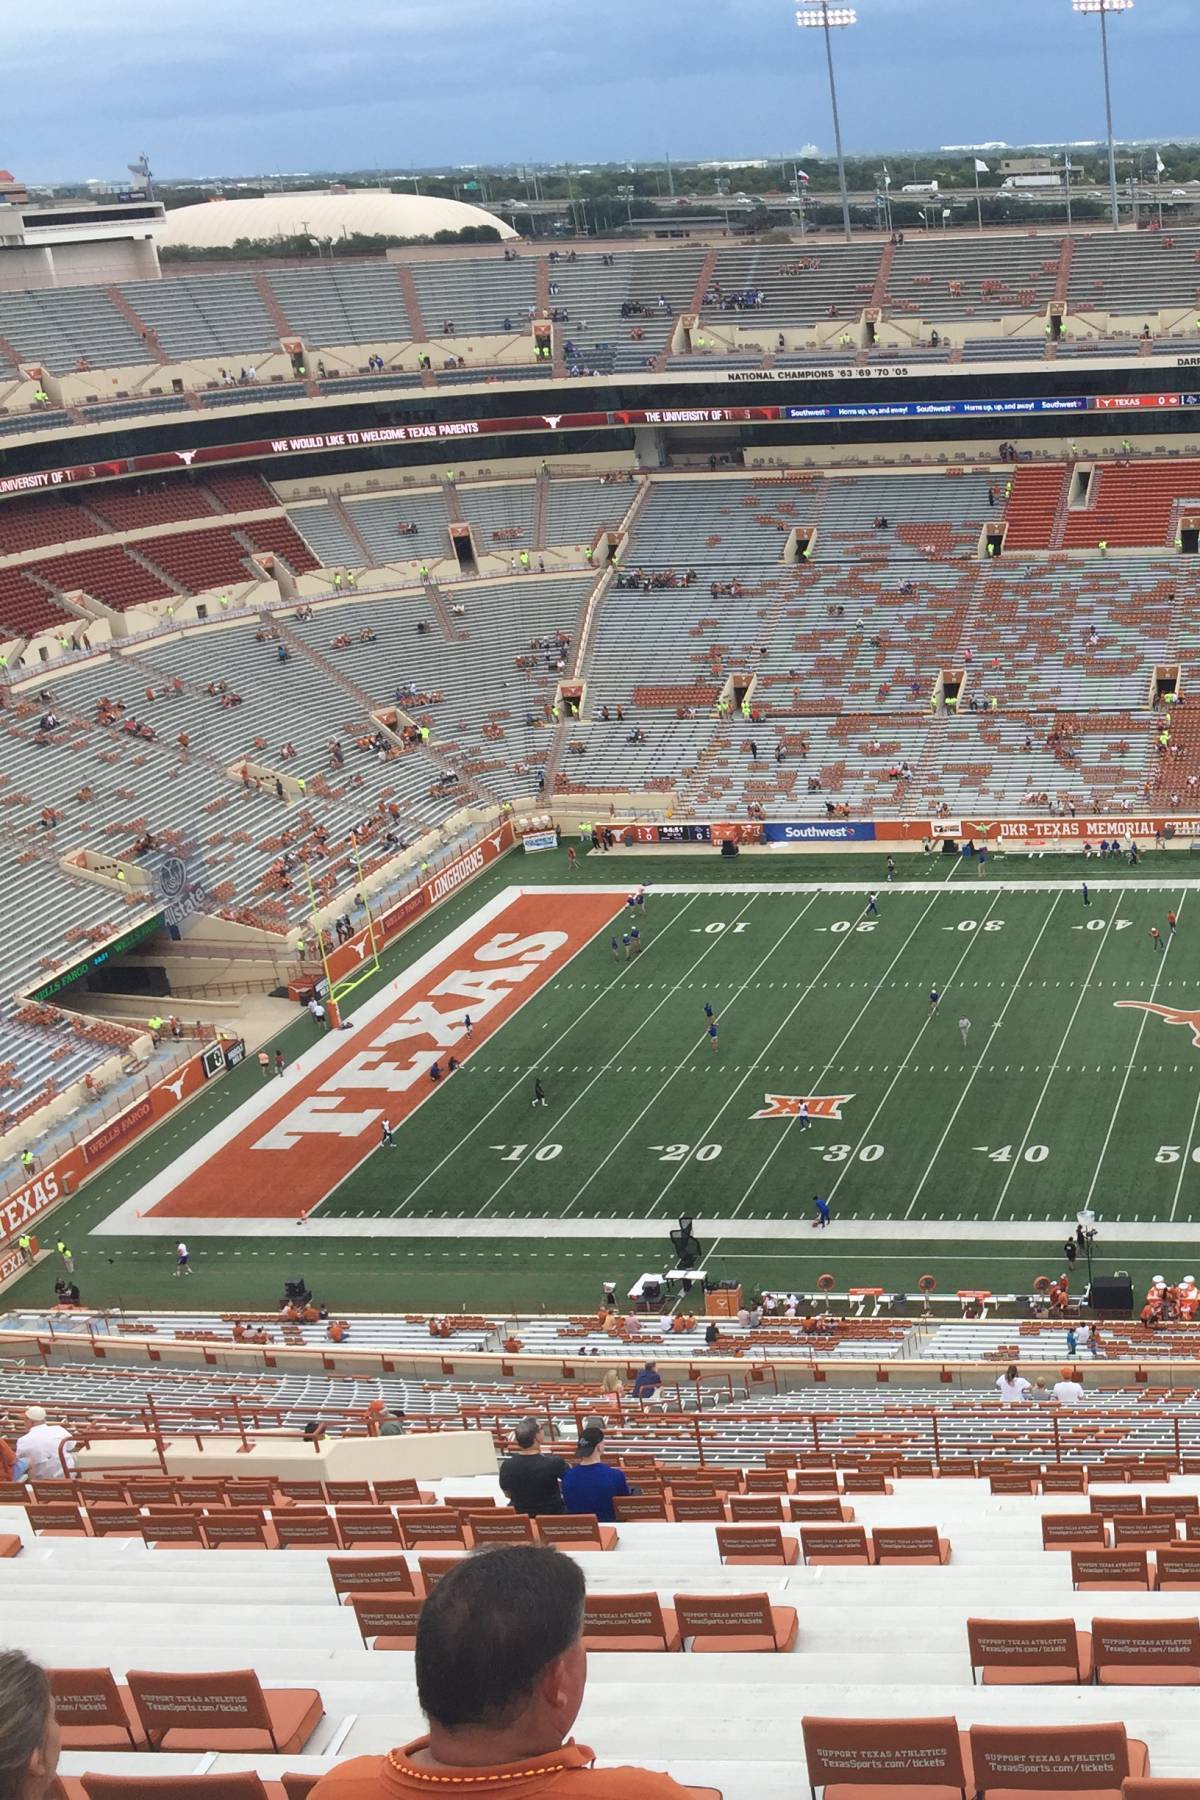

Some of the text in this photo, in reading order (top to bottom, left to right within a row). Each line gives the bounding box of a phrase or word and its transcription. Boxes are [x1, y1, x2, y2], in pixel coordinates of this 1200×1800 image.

[727, 371, 775, 381] NATIONAL
[777, 370, 834, 380] CHAMPIONS
[837, 369, 852, 378] '63
[874, 368, 888, 377] '70
[892, 367, 908, 376] '05
[1042, 400, 1077, 409] Southwest
[1114, 398, 1140, 407] TEXAS
[1158, 396, 1165, 405] 0
[790, 408, 825, 418] Southwest
[916, 404, 951, 413] Southwest
[645, 411, 661, 423] THE
[662, 411, 710, 423] UNIVERSITY
[711, 410, 722, 421] OF
[271, 422, 479, 453] WE WOULD LIKE TO WELCOME TEXAS PARENTS
[51, 472, 64, 484] OF
[785, 826, 847, 837] Southwest
[1000, 822, 1080, 836] DKR-TEXAS
[1086, 821, 1158, 835] MEMORIAL
[646, 833, 653, 841] 0
[696, 832, 703, 840] 0
[427, 847, 485, 904] LONGHORNS
[164, 887, 205, 927] Allstate
[703, 922, 752, 934] 10
[829, 921, 880, 933] 20
[957, 920, 1006, 932] 30
[1085, 919, 1133, 931] 40
[31, 963, 89, 1002] WELLS FARGO
[249, 929, 569, 1150] TEXAS
[213, 1050, 223, 1067] 0
[89, 1104, 150, 1155] WELLS FARGO
[501, 1143, 564, 1161] 10
[659, 1143, 723, 1162] 20
[822, 1144, 885, 1162] 30
[988, 1144, 1050, 1163] 40
[1031, 1637, 1067, 1645] ATHLETICS
[140, 1693, 247, 1703] SUPPORT TEXAS ATHLETICS
[816, 1747, 947, 1759] SUPPORT TEXAS ATHLETICS
[984, 1752, 1116, 1763] SUPPORT TEXAS ATHLETICS
